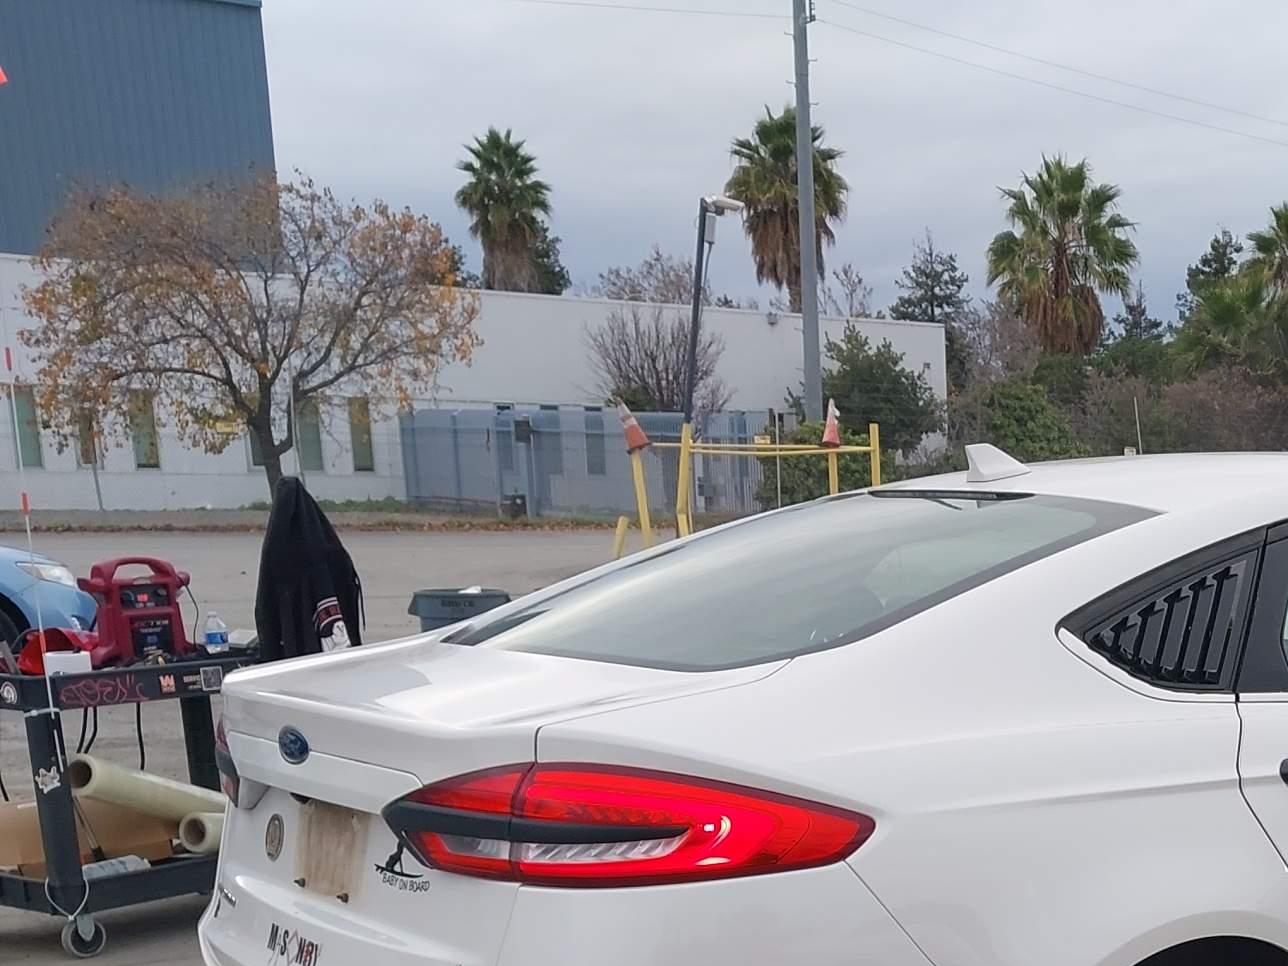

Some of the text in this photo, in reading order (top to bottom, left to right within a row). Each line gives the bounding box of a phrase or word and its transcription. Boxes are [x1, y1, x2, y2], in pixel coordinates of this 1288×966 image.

[382, 872, 430, 892] BABY ON BOARD
